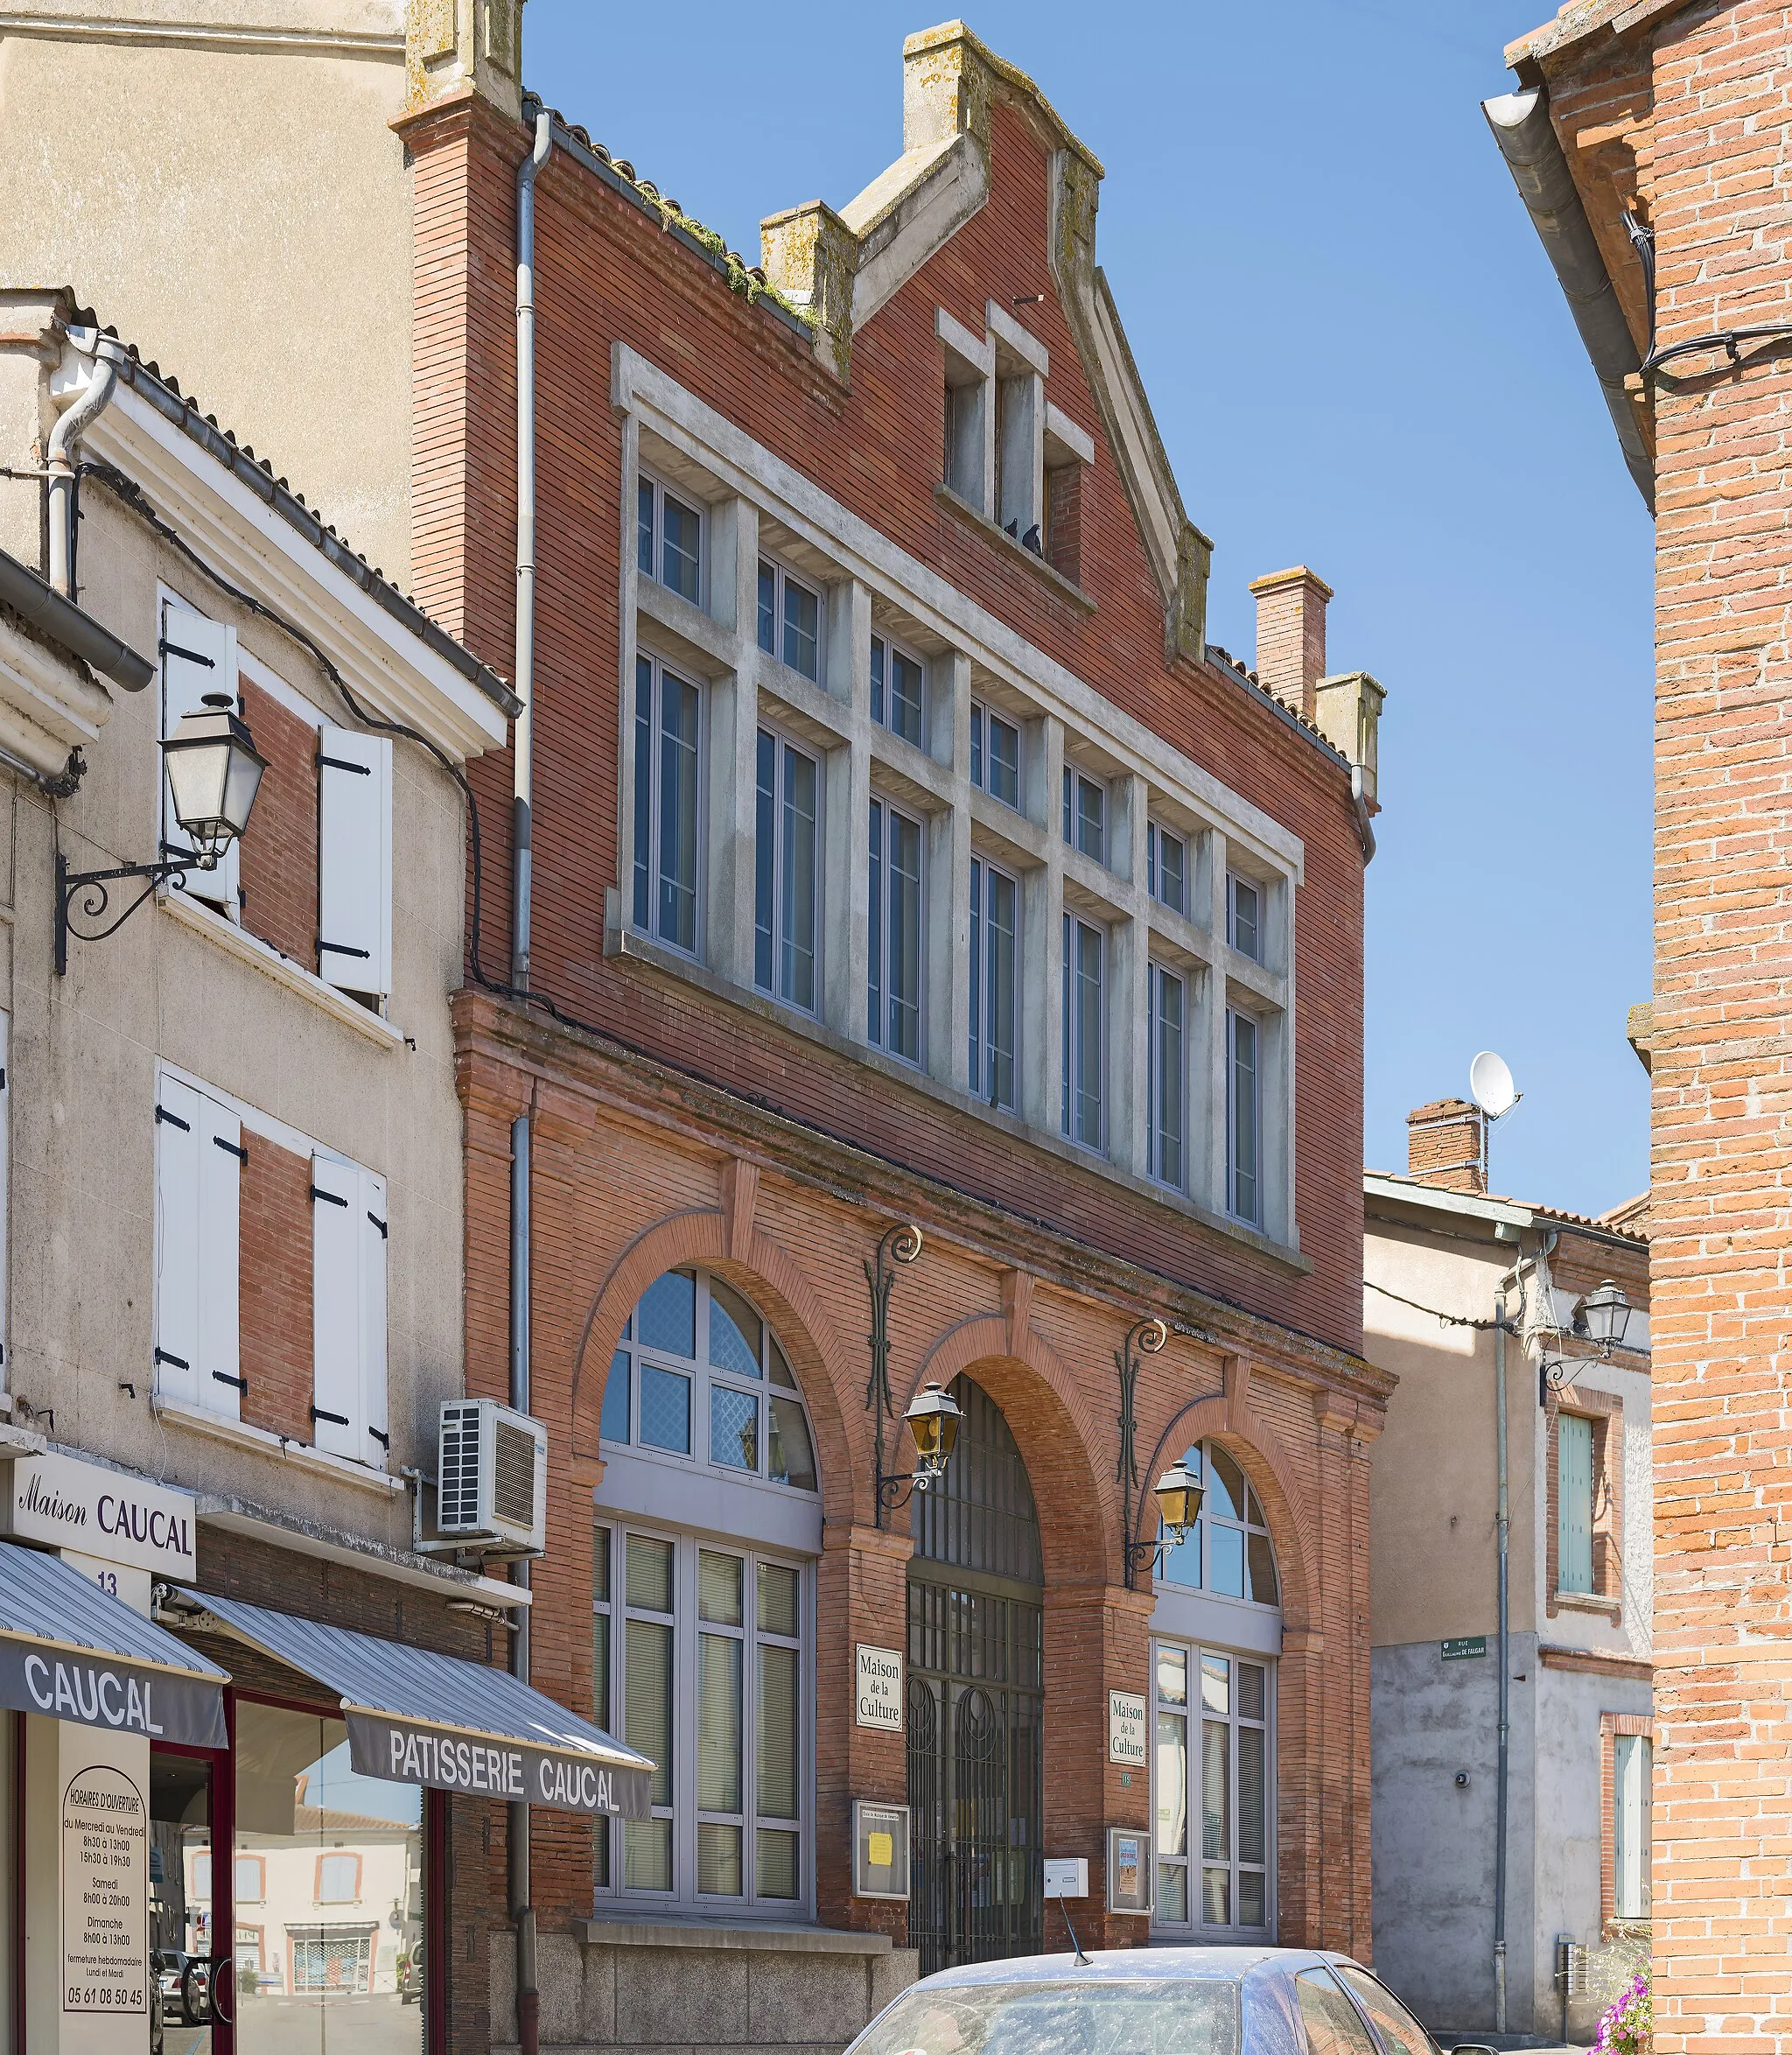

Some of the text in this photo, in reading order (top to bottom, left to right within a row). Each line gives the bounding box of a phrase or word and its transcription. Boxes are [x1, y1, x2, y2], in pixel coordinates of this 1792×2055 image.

[18, 1473, 192, 1556] Maison CAUCAL
[97, 1571, 117, 1597] 13
[860, 1654, 900, 1679] Maison
[24, 1654, 164, 1735] CAUCAL
[871, 1680, 889, 1696] de la
[860, 1696, 900, 1721] Culture
[1113, 1700, 1143, 1721] Maison
[1120, 1722, 1135, 1735] de la
[1113, 1736, 1143, 1757] Culture
[390, 1729, 620, 1812] PATISSERIE CAUCAL
[70, 1789, 139, 1812] HORAIRES D'OUVERTURE
[65, 1818, 74, 1828] du
[75, 1819, 105, 1833] Mercredi
[116, 1824, 145, 1837] Vendredi
[83, 1835, 130, 1851] 8h30 à 13h00
[80, 1851, 130, 1867] 15h30 à 19h30
[92, 1876, 118, 1890] Samedi
[83, 1892, 130, 1907] 8h00 à 20h00
[88, 1916, 122, 1929] Dimanche
[83, 1932, 130, 1946] 8h00 à 13h00
[67, 1953, 142, 1967] fermeture hebdomadaire
[87, 1967, 101, 1977] Lundi
[108, 1969, 124, 1978] Mardi
[68, 1987, 142, 2005] 05 61 08 50 45
